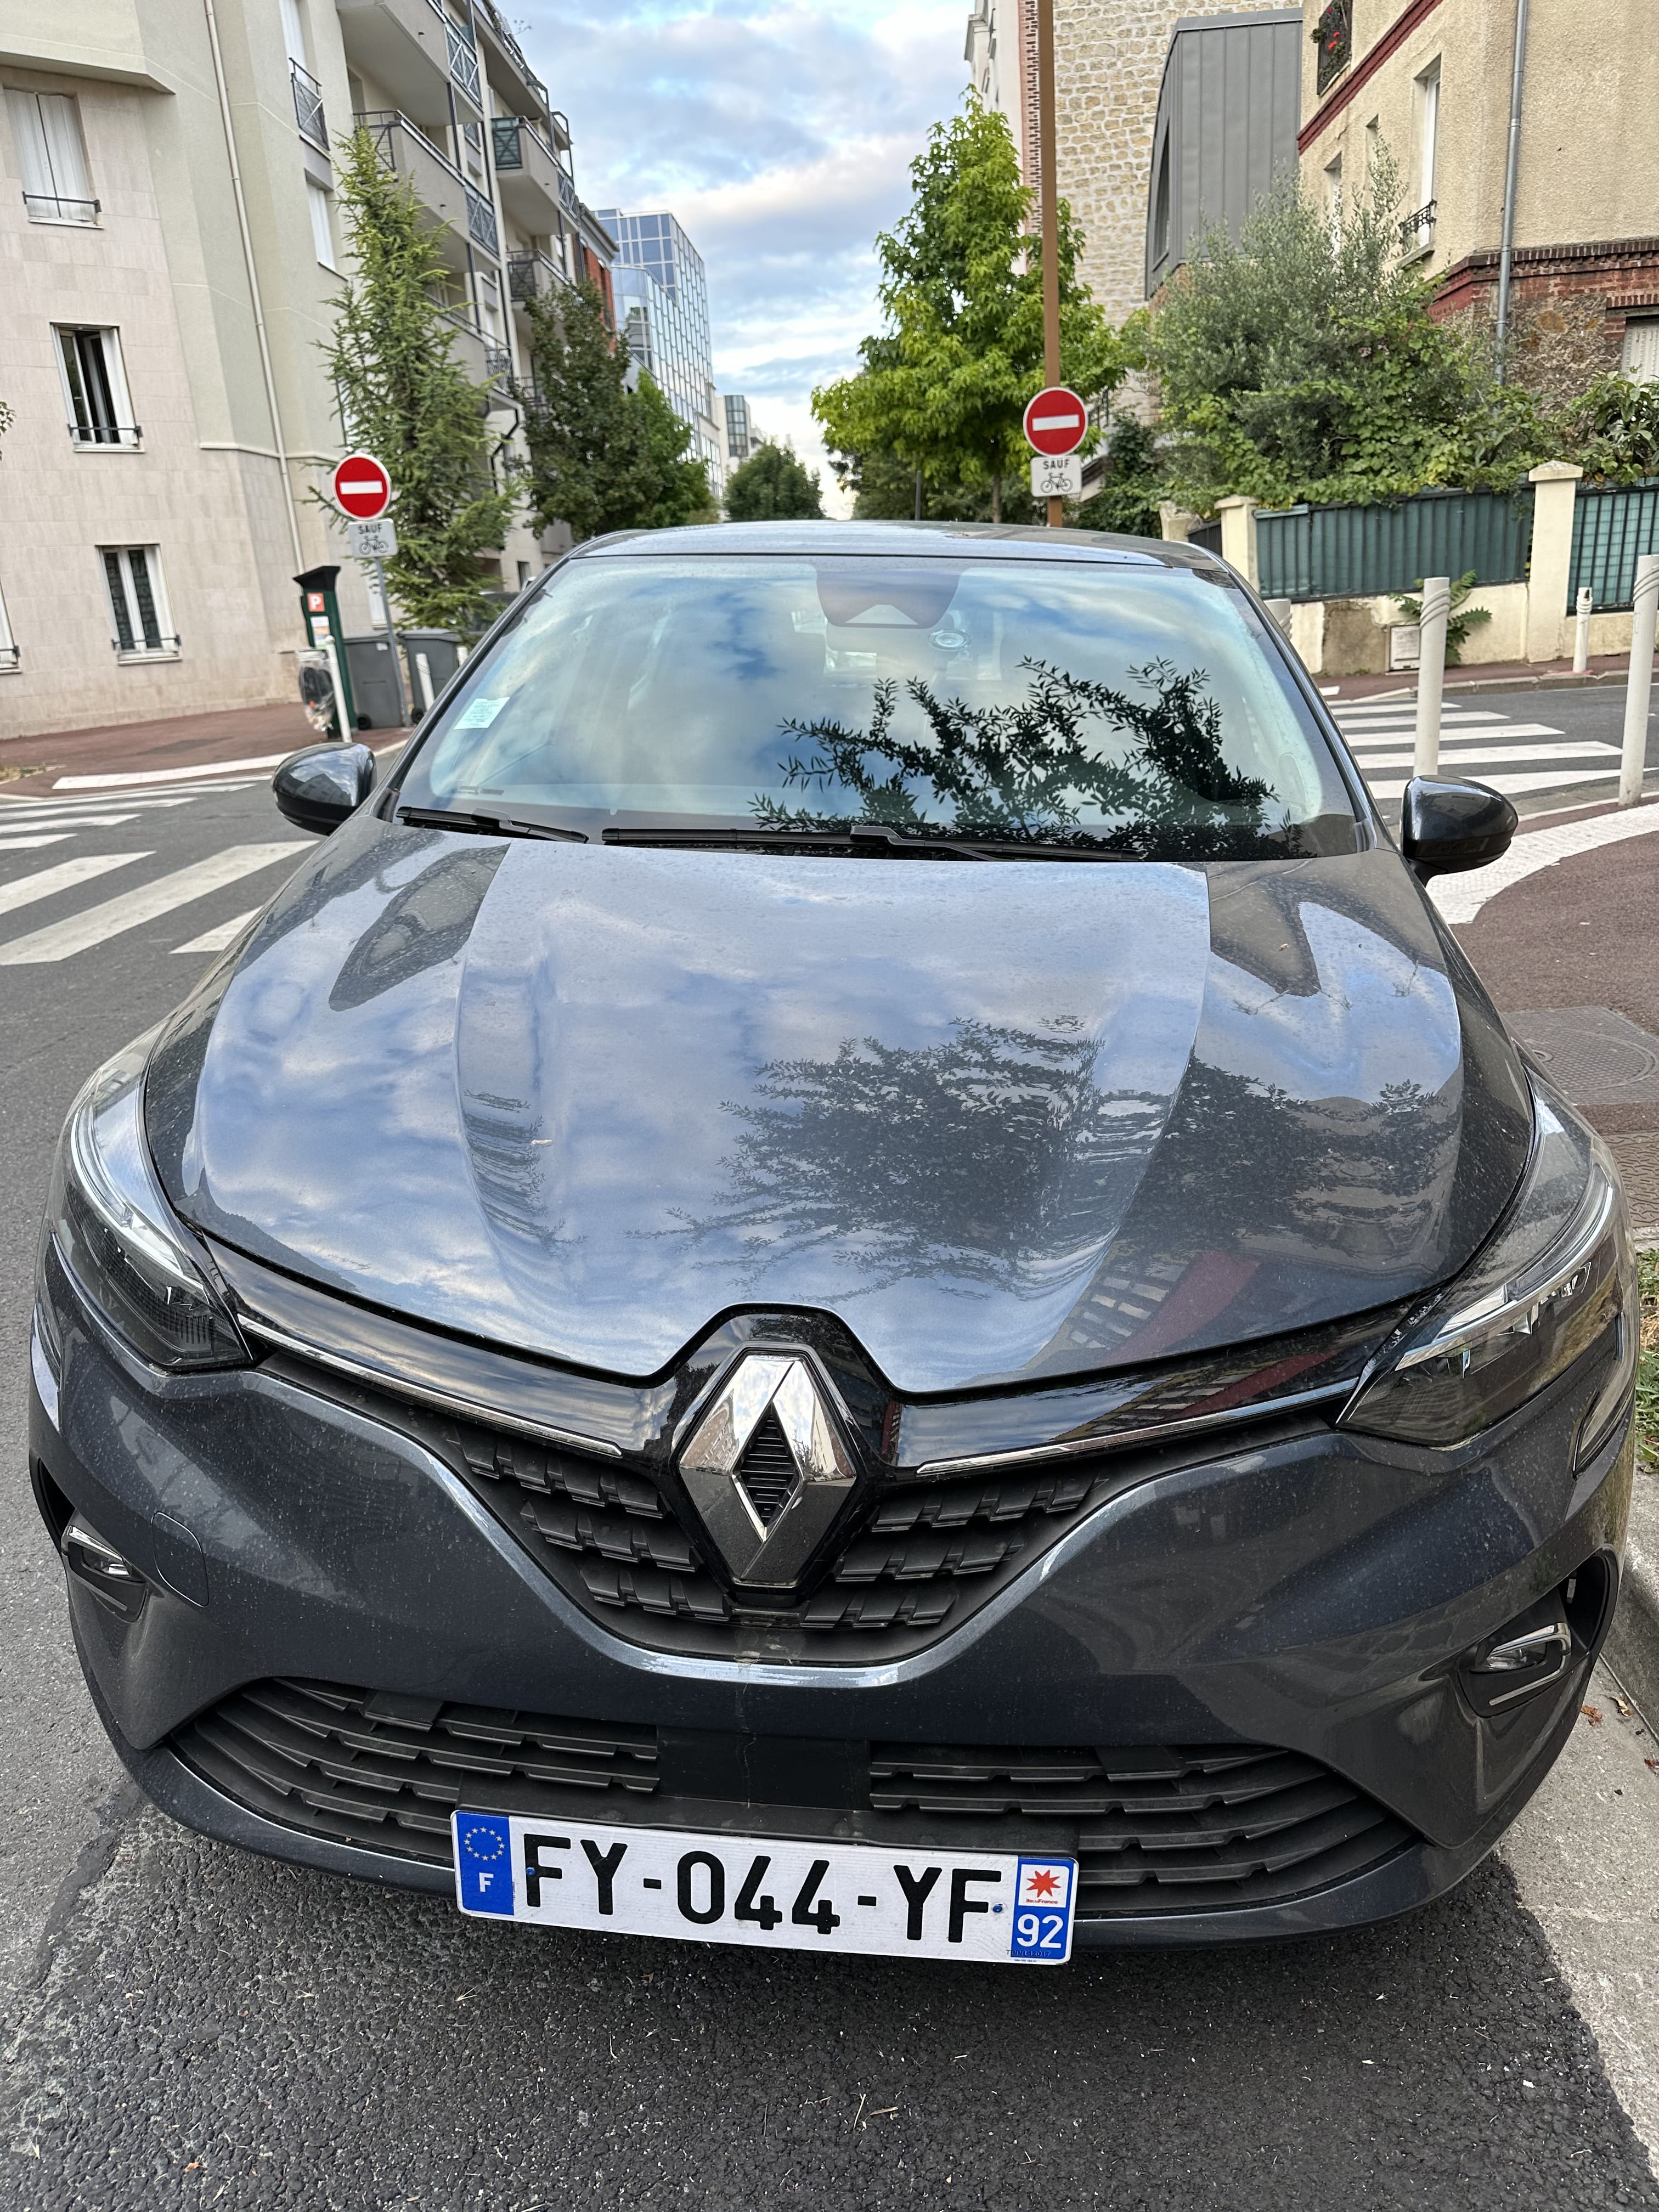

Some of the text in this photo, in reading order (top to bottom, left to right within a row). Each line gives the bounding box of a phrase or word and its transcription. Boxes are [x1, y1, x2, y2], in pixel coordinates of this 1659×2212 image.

[1043, 459, 1070, 470] SAUF
[357, 523, 382, 534] SAUF
[311, 596, 322, 610] P
[479, 1872, 494, 1893] F
[524, 1833, 1002, 1943] FY-044-YF
[1017, 1914, 1064, 1949] 92
